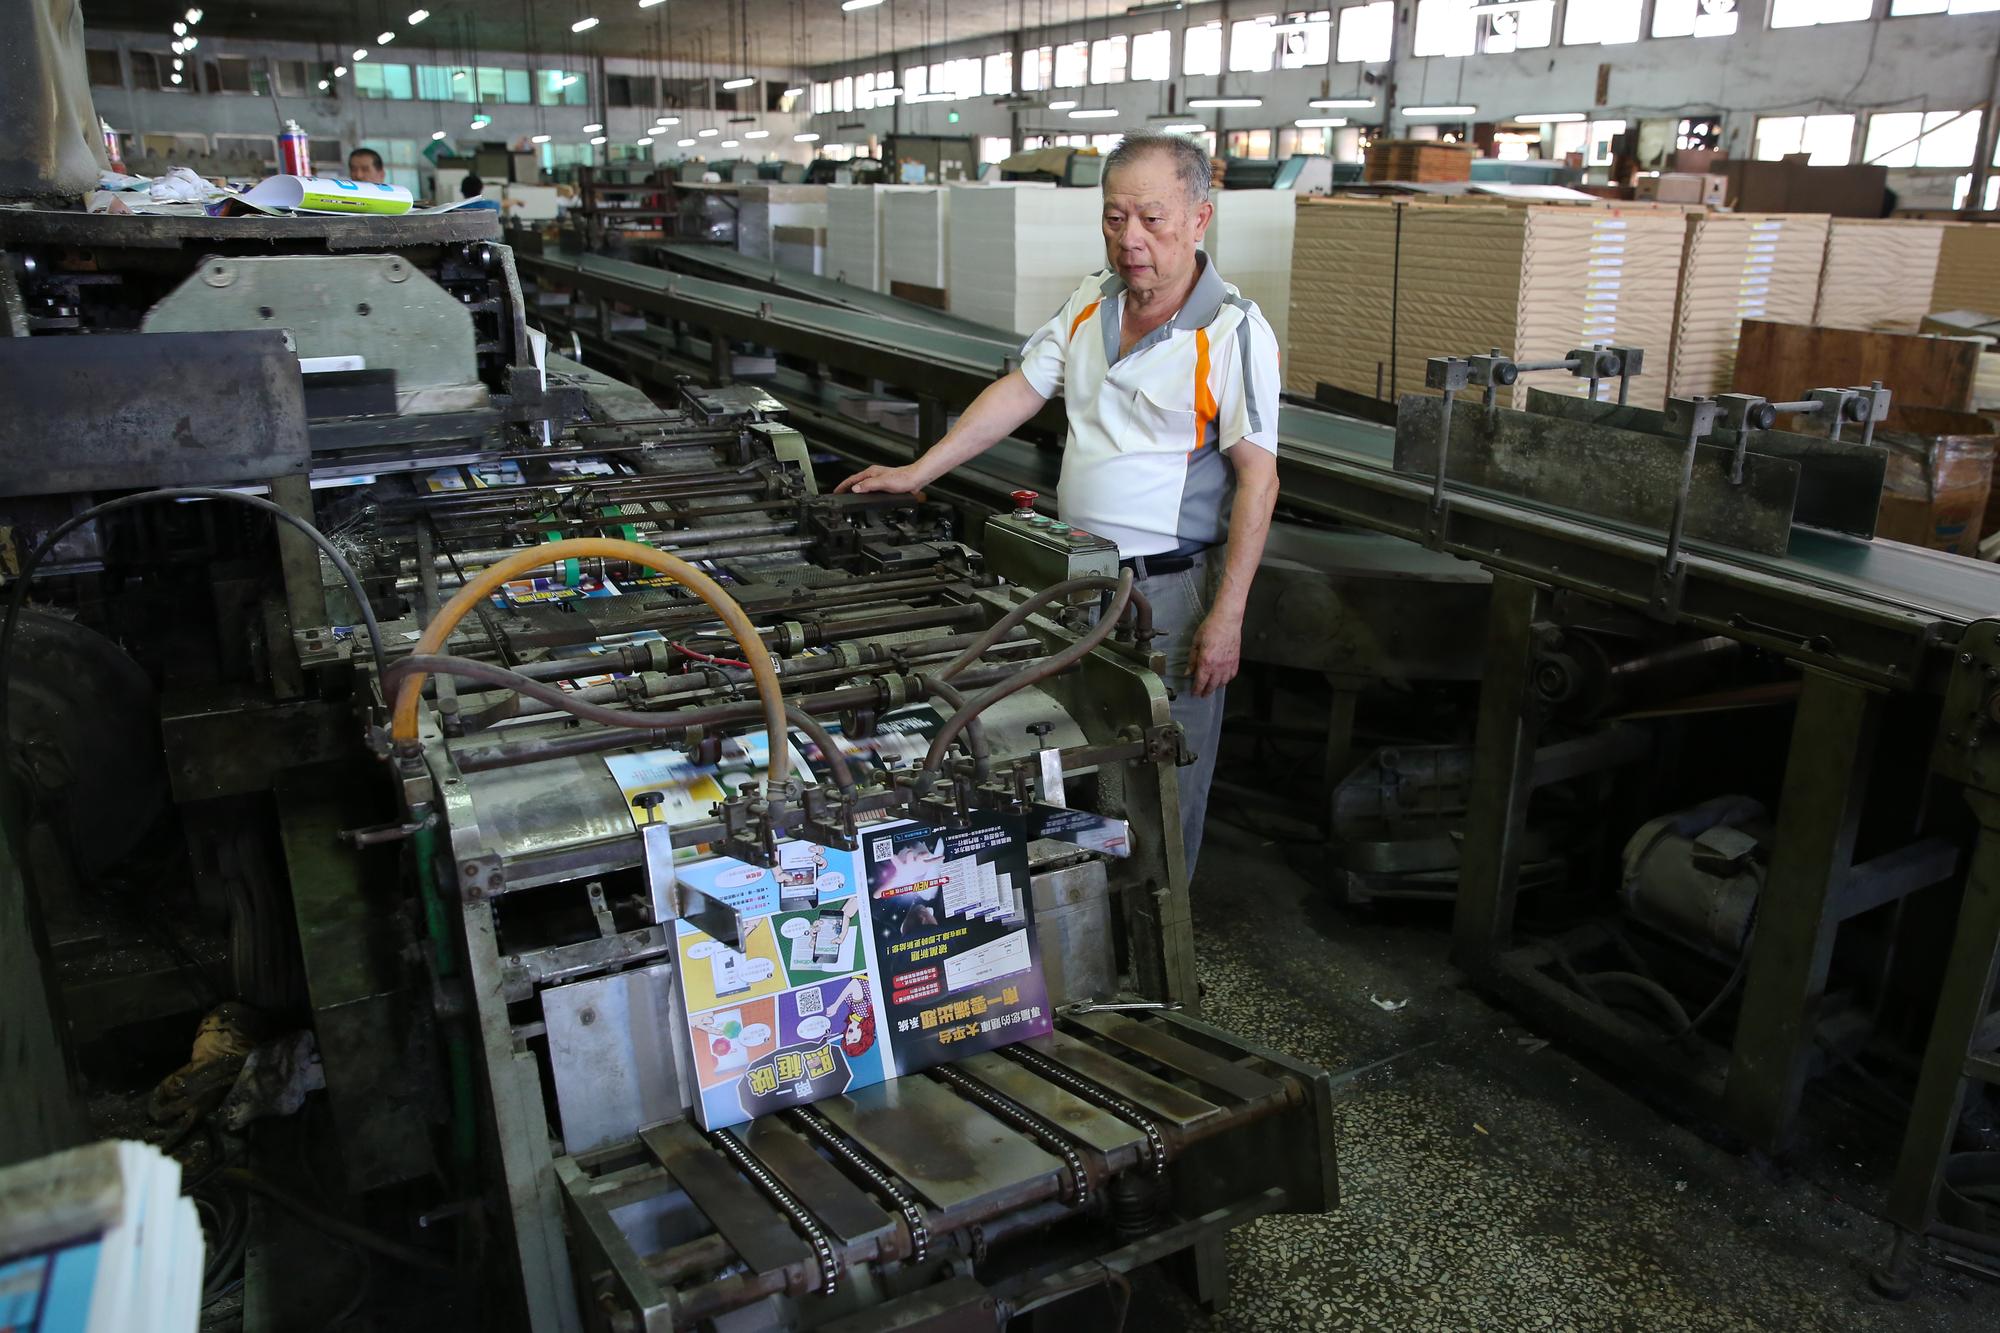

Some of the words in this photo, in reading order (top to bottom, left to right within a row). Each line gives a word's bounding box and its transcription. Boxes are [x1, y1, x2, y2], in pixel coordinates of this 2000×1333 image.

[748, 1047, 835, 1096] 照框映
[775, 1079, 813, 1097] 南一
